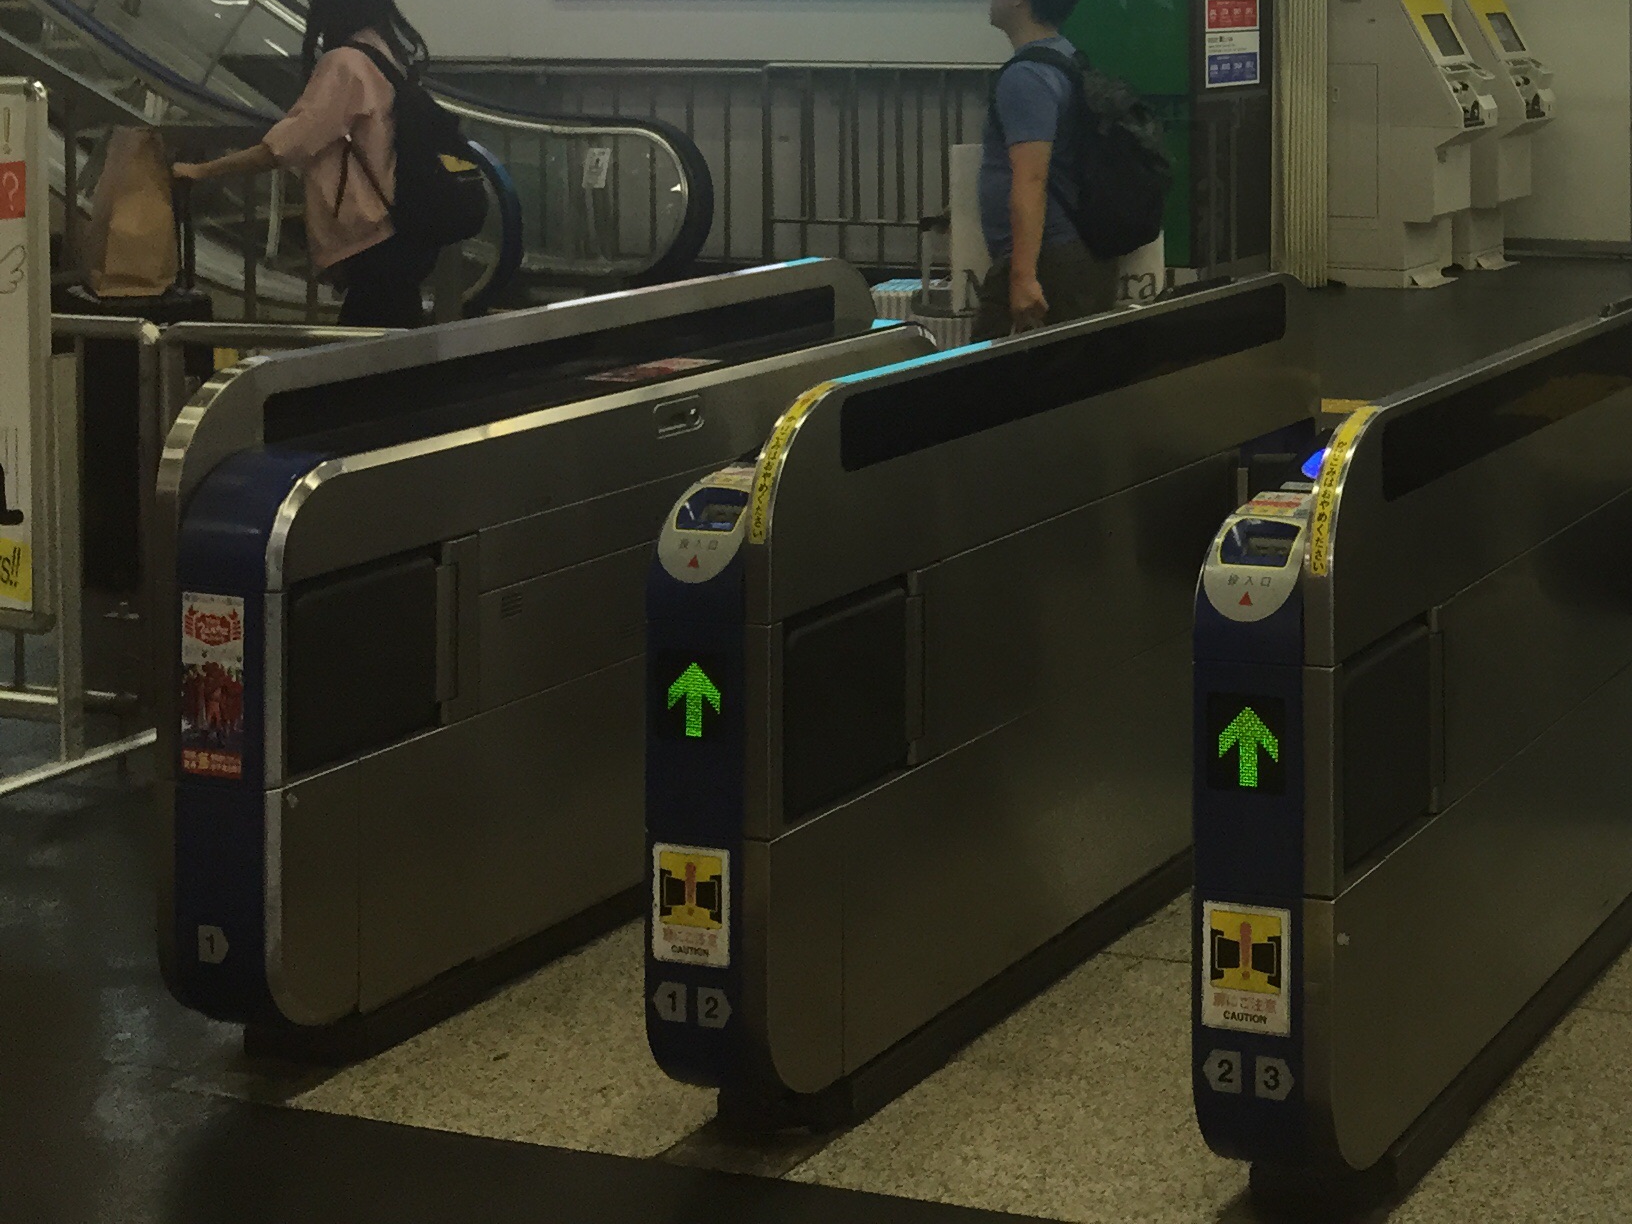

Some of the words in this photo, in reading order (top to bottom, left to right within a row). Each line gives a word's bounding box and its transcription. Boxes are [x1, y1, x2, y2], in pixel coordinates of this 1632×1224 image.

[671, 945, 710, 957] CAUTION
[667, 990, 677, 1013] 1
[704, 996, 721, 1019] 2
[1223, 1010, 1268, 1025] CAUTION
[1217, 1059, 1233, 1084] 2
[1263, 1065, 1281, 1091] 3
